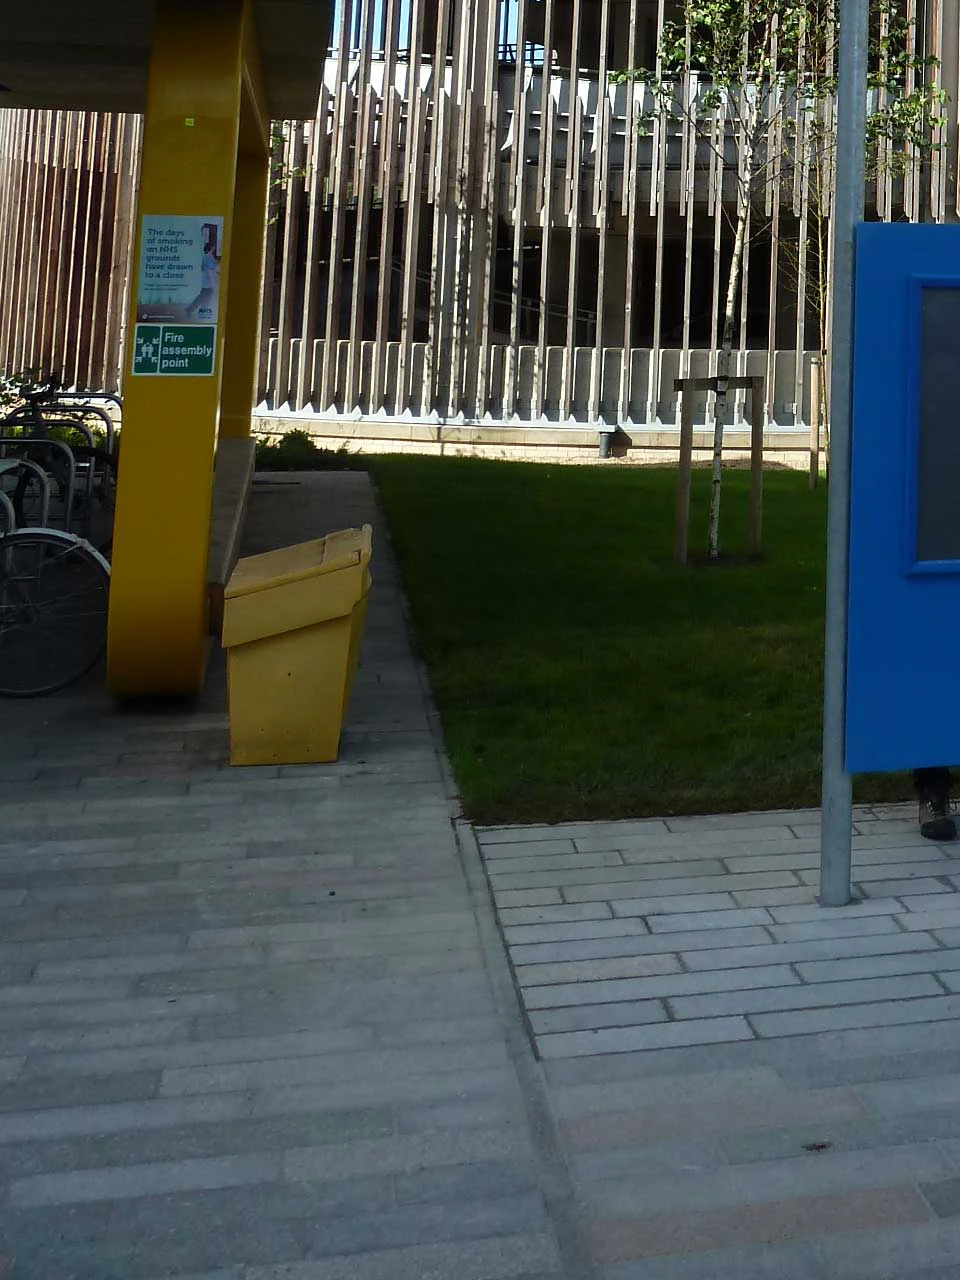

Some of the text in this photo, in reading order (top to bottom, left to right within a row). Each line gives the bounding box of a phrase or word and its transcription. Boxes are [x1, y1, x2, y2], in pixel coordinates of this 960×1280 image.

[147, 228, 185, 237] The days
[157, 238, 194, 246] smoking
[145, 255, 180, 263] grounds
[167, 263, 193, 271] drawn
[164, 332, 185, 342] Fire
[162, 345, 212, 357] assembly
[161, 358, 189, 369] point
